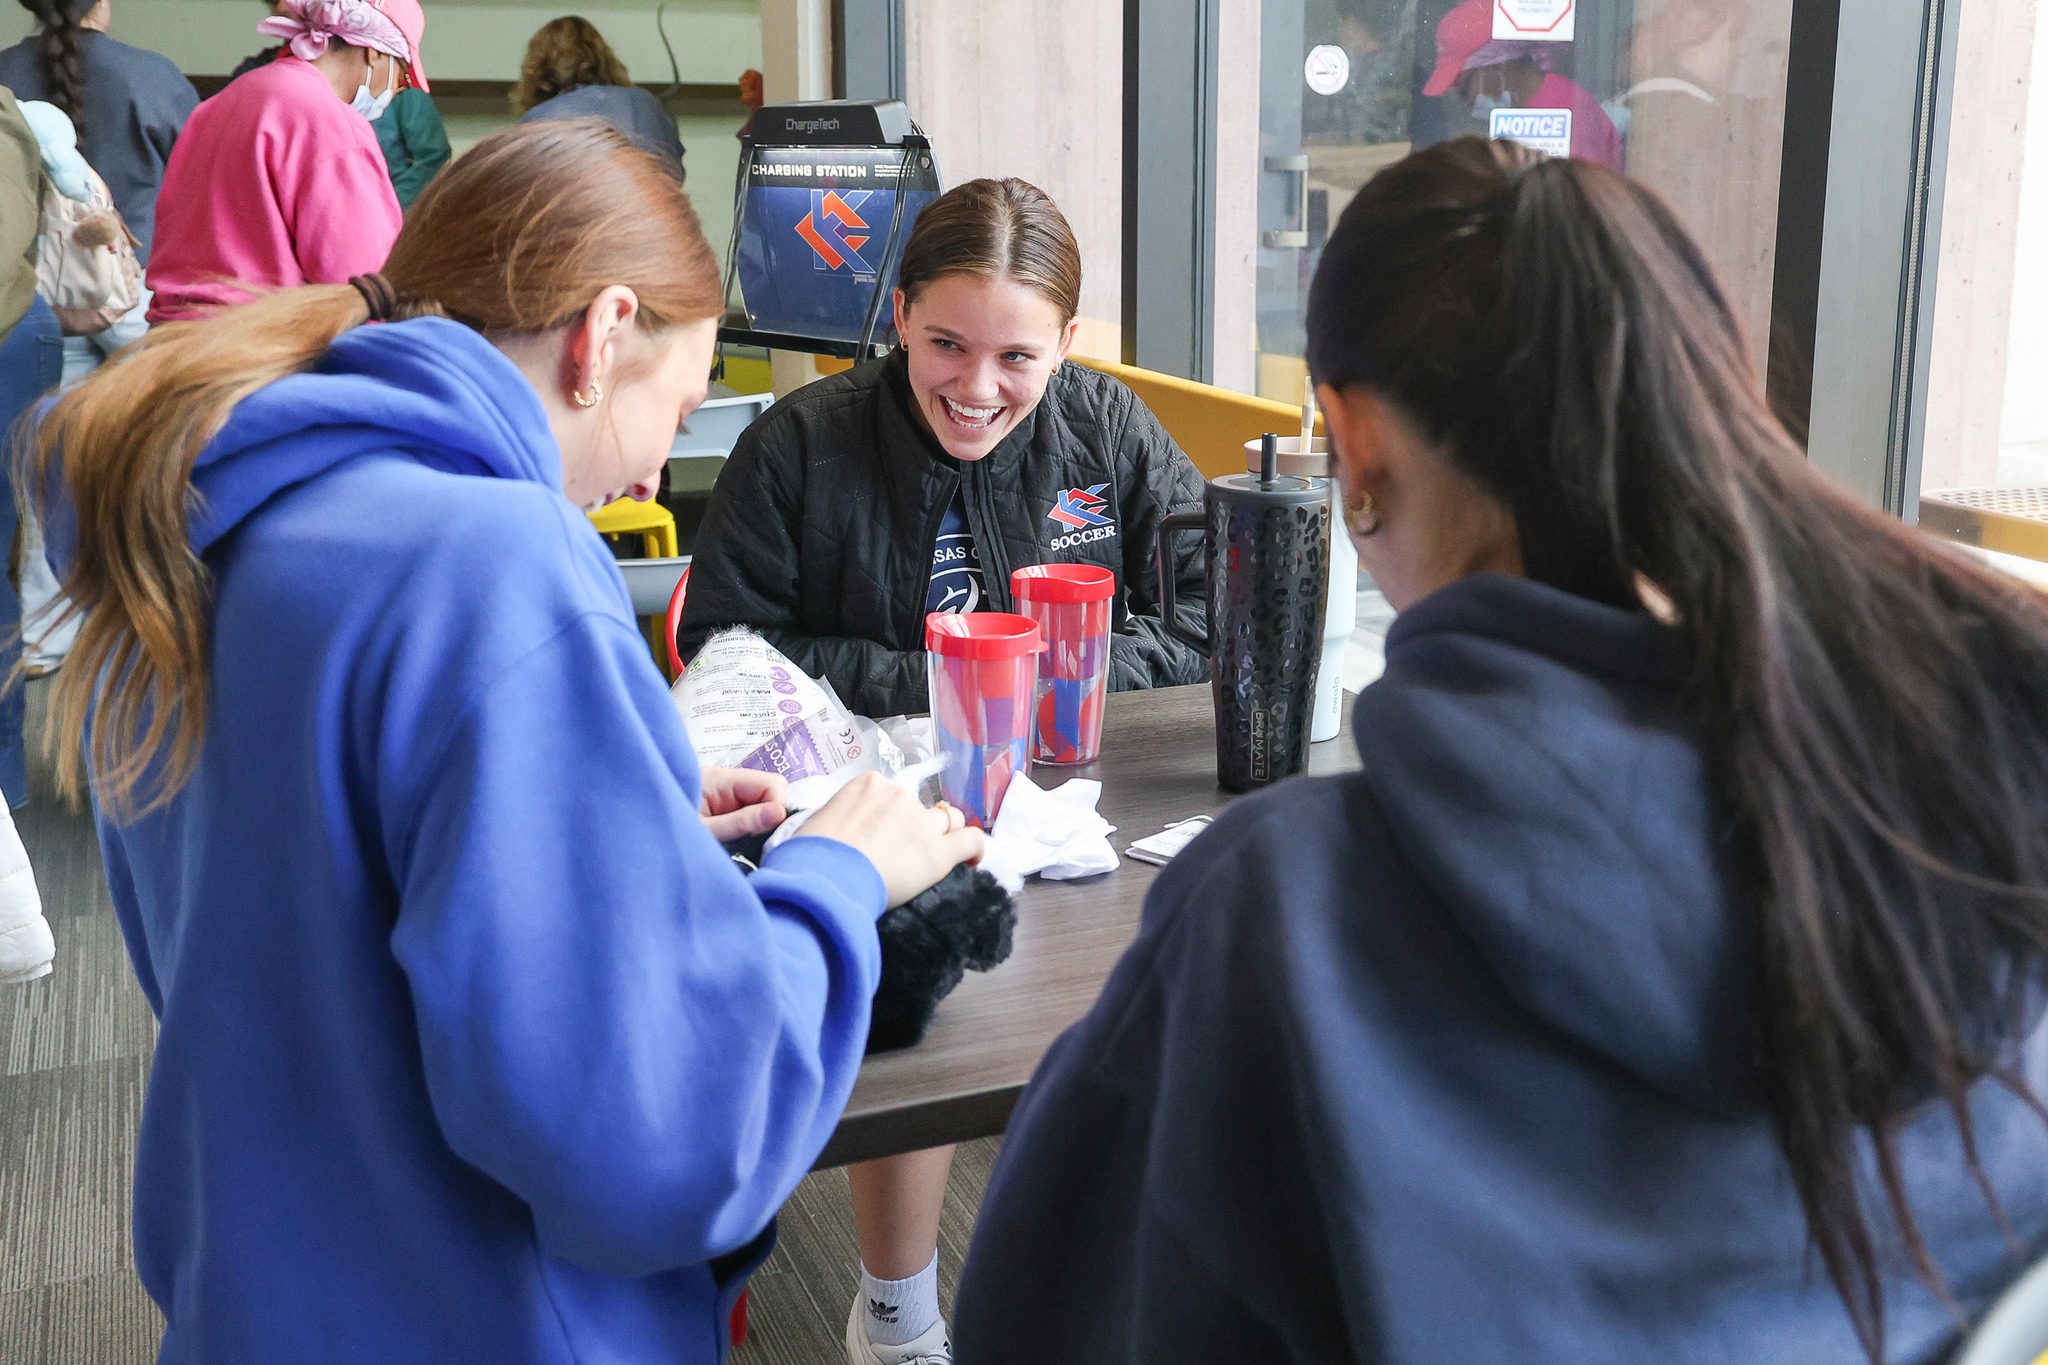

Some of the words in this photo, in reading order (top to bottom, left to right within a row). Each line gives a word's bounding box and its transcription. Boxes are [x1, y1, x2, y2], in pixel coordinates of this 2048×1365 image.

[786, 118, 840, 134] ChargeTech
[1495, 116, 1566, 136] NOTICE
[751, 164, 812, 177] CHARGING
[816, 164, 867, 177] STATION
[1050, 525, 1117, 552] SOCCER
[933, 546, 967, 565] SAS
[712, 636, 746, 645] WARNING
